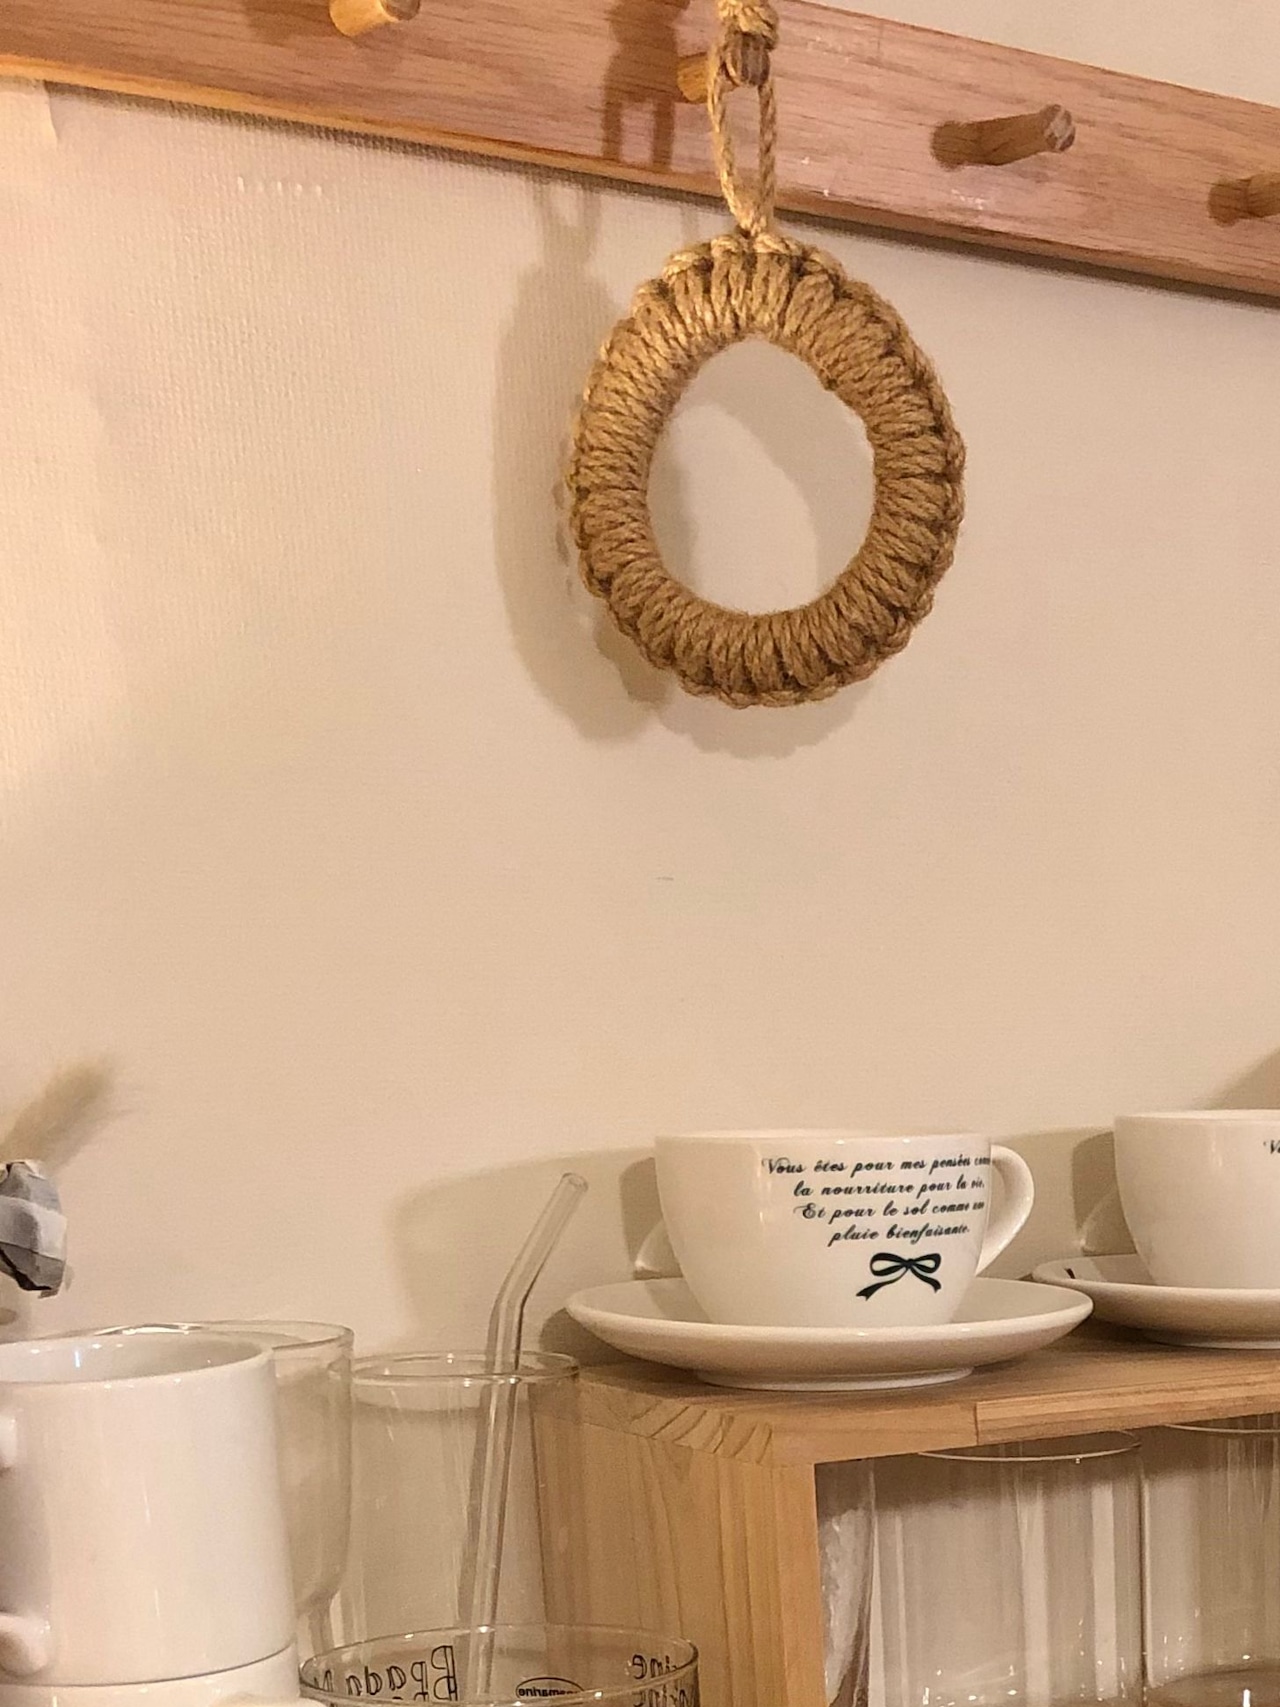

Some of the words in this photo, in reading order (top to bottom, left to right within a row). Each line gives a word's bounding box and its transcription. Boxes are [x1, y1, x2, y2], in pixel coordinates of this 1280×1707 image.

[762, 1156, 806, 1174] Vous
[813, 1159, 847, 1173] êtes
[850, 1161, 894, 1178] pour
[900, 1159, 927, 1169] mes
[929, 1154, 971, 1175] pensées
[793, 1181, 813, 1197] la
[820, 1181, 914, 1196] nourriture
[916, 1181, 951, 1199] pour
[956, 1174, 968, 1190] la
[793, 1202, 826, 1219] Et
[828, 1207, 876, 1224] pour
[882, 1200, 898, 1217] le
[903, 1199, 930, 1216] sol
[932, 1202, 969, 1214] comme
[828, 1223, 879, 1247] pluie
